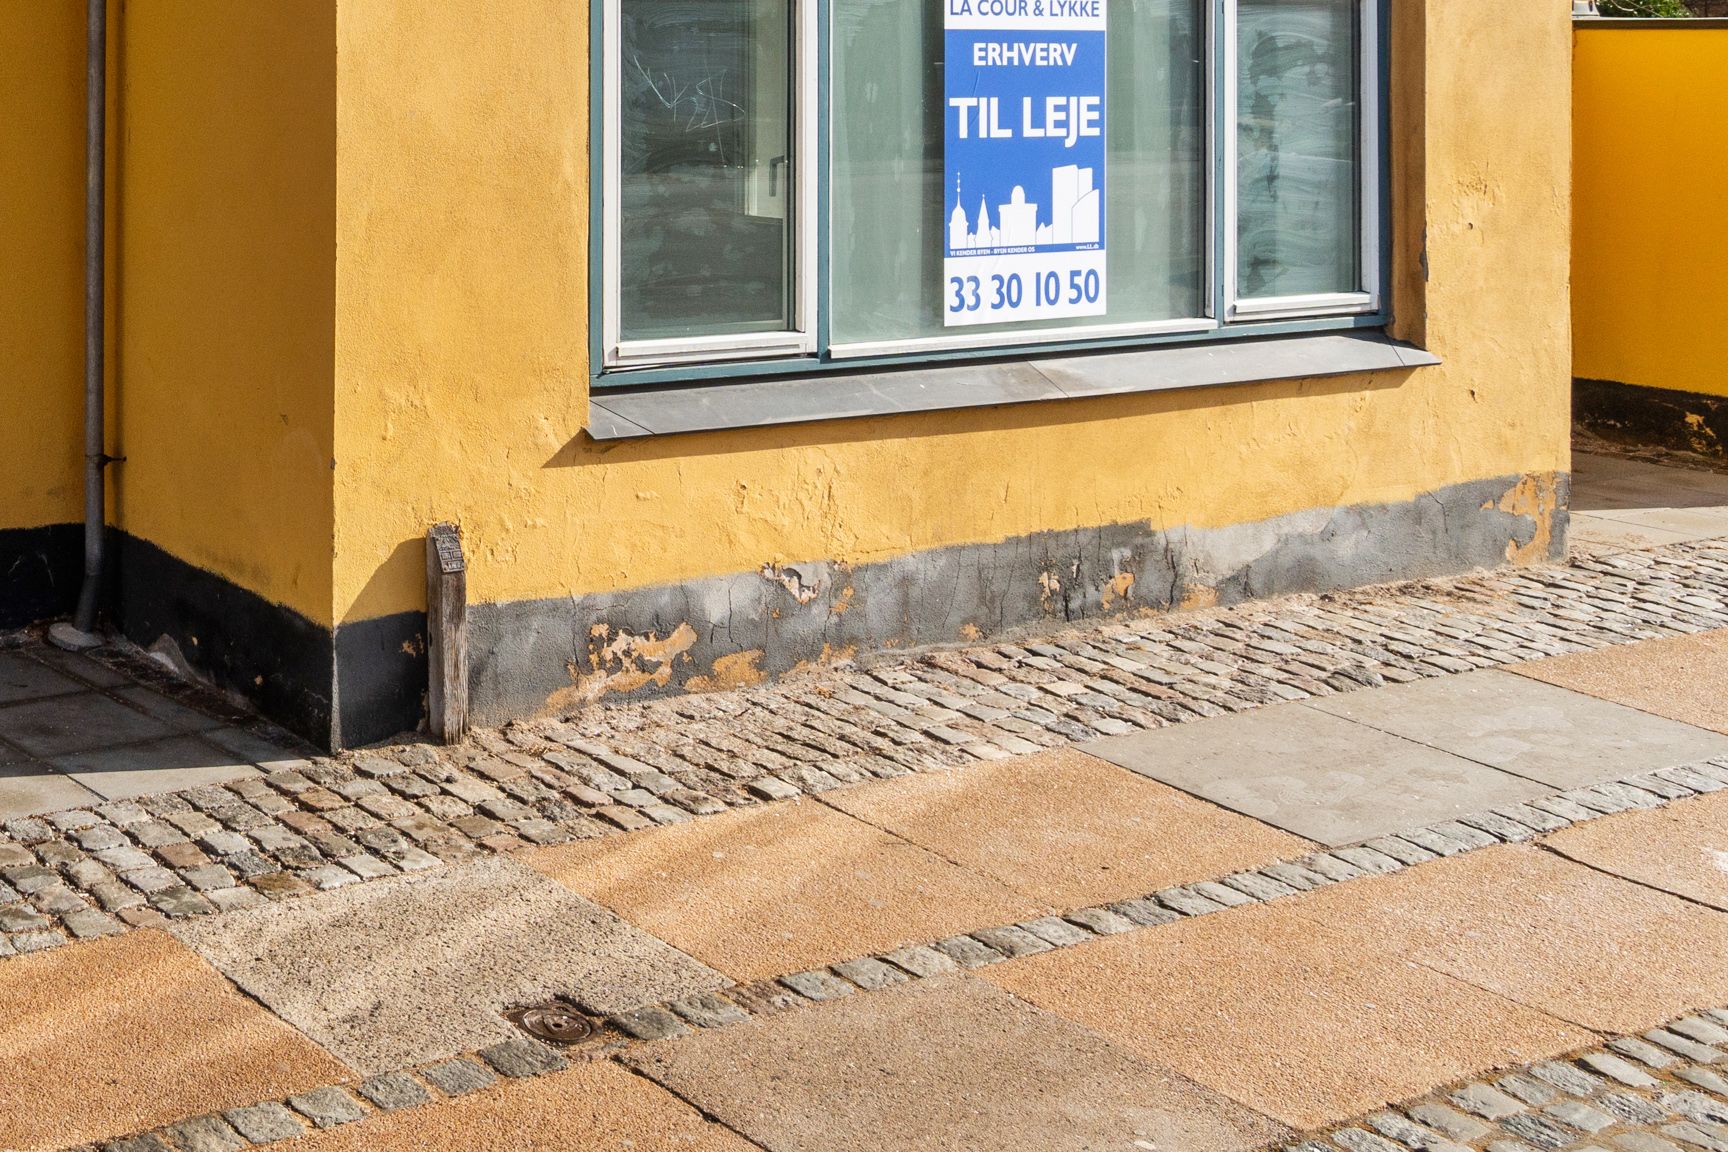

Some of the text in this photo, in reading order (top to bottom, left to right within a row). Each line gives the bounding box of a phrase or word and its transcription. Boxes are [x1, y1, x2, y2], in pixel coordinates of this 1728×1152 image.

[978, 0, 1029, 17] COUR
[1033, 0, 1045, 17] &
[1050, 0, 1100, 18] LYKKE
[973, 42, 1078, 66] ERHVERV
[949, 95, 1101, 148] TIL LEJE
[950, 268, 1100, 313] 33 30 10 50
